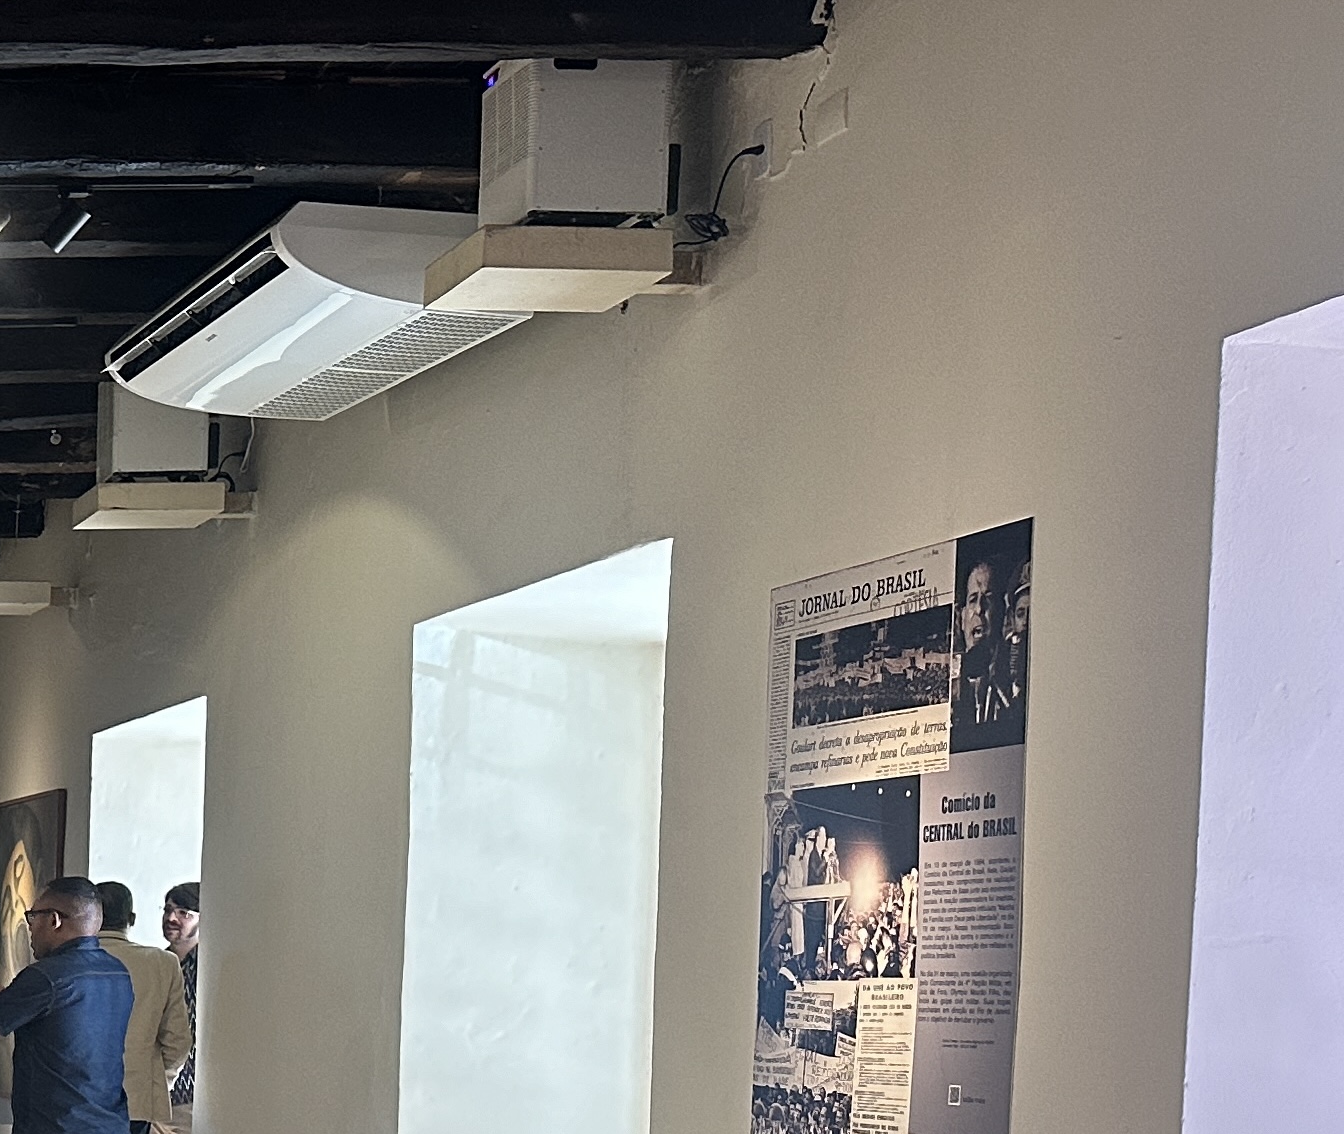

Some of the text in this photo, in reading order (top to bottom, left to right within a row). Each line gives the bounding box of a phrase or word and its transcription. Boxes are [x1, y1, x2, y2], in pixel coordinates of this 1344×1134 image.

[799, 589, 846, 617] JORNAL
[851, 582, 871, 605] DO
[875, 568, 926, 597] BRASIL
[941, 792, 996, 814] Comício da
[923, 817, 1017, 843] CENTRAL do BRASIL
